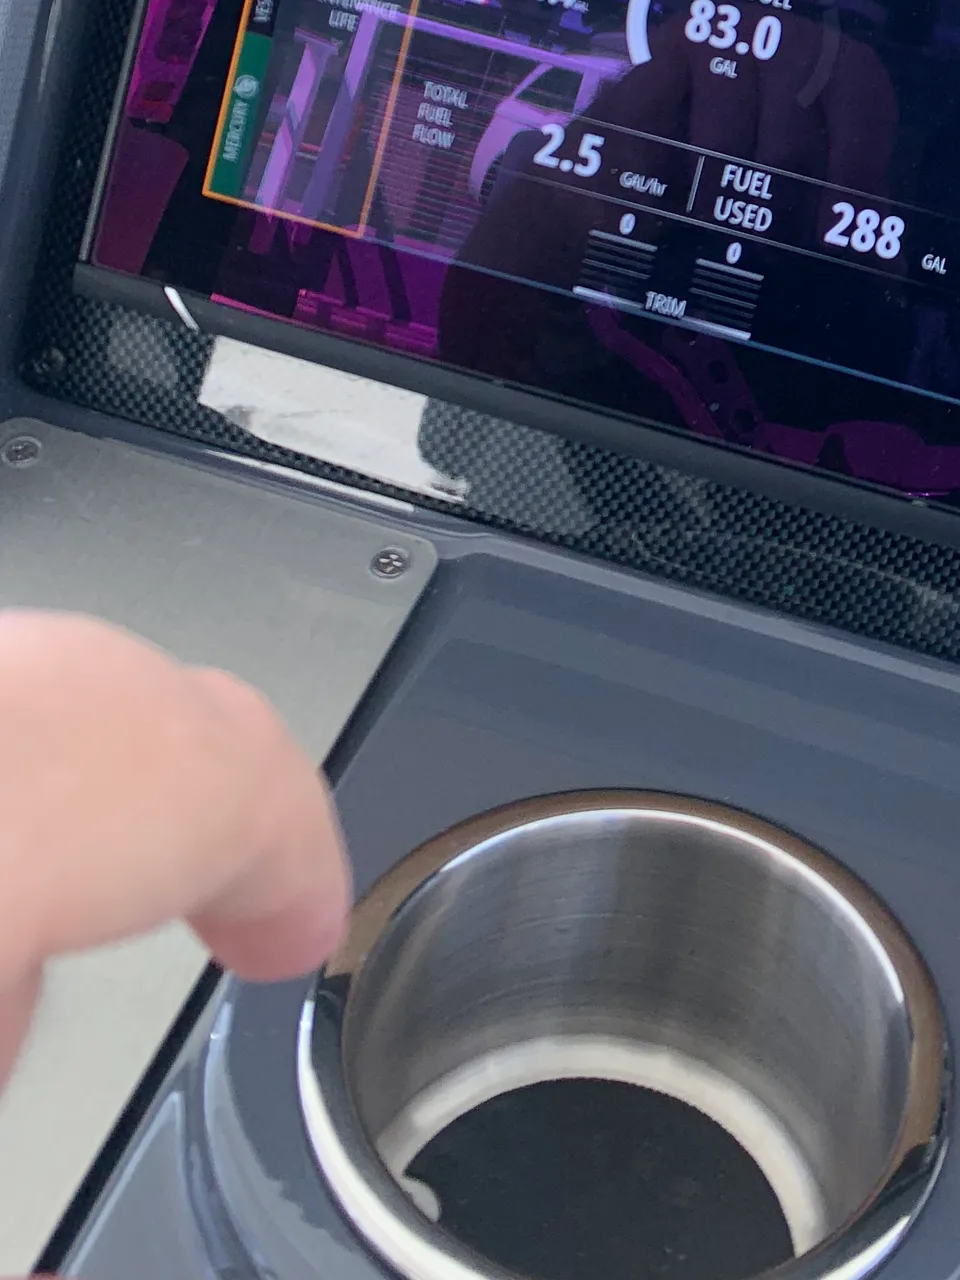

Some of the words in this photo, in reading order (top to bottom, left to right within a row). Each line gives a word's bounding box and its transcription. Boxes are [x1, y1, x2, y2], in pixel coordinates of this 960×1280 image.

[709, 56, 738, 79] GAL
[423, 81, 469, 109] TOTAL
[417, 103, 453, 127] FUEL
[412, 124, 456, 150] FLOW
[532, 123, 605, 177] 2.5
[619, 171, 668, 197] GAL/hr
[720, 163, 773, 200] FUEL
[619, 213, 636, 235] 0
[713, 196, 772, 232] USED
[824, 201, 906, 259] 288
[921, 253, 947, 275] GAL
[726, 241, 742, 264] 0
[645, 291, 688, 318] TRIM
